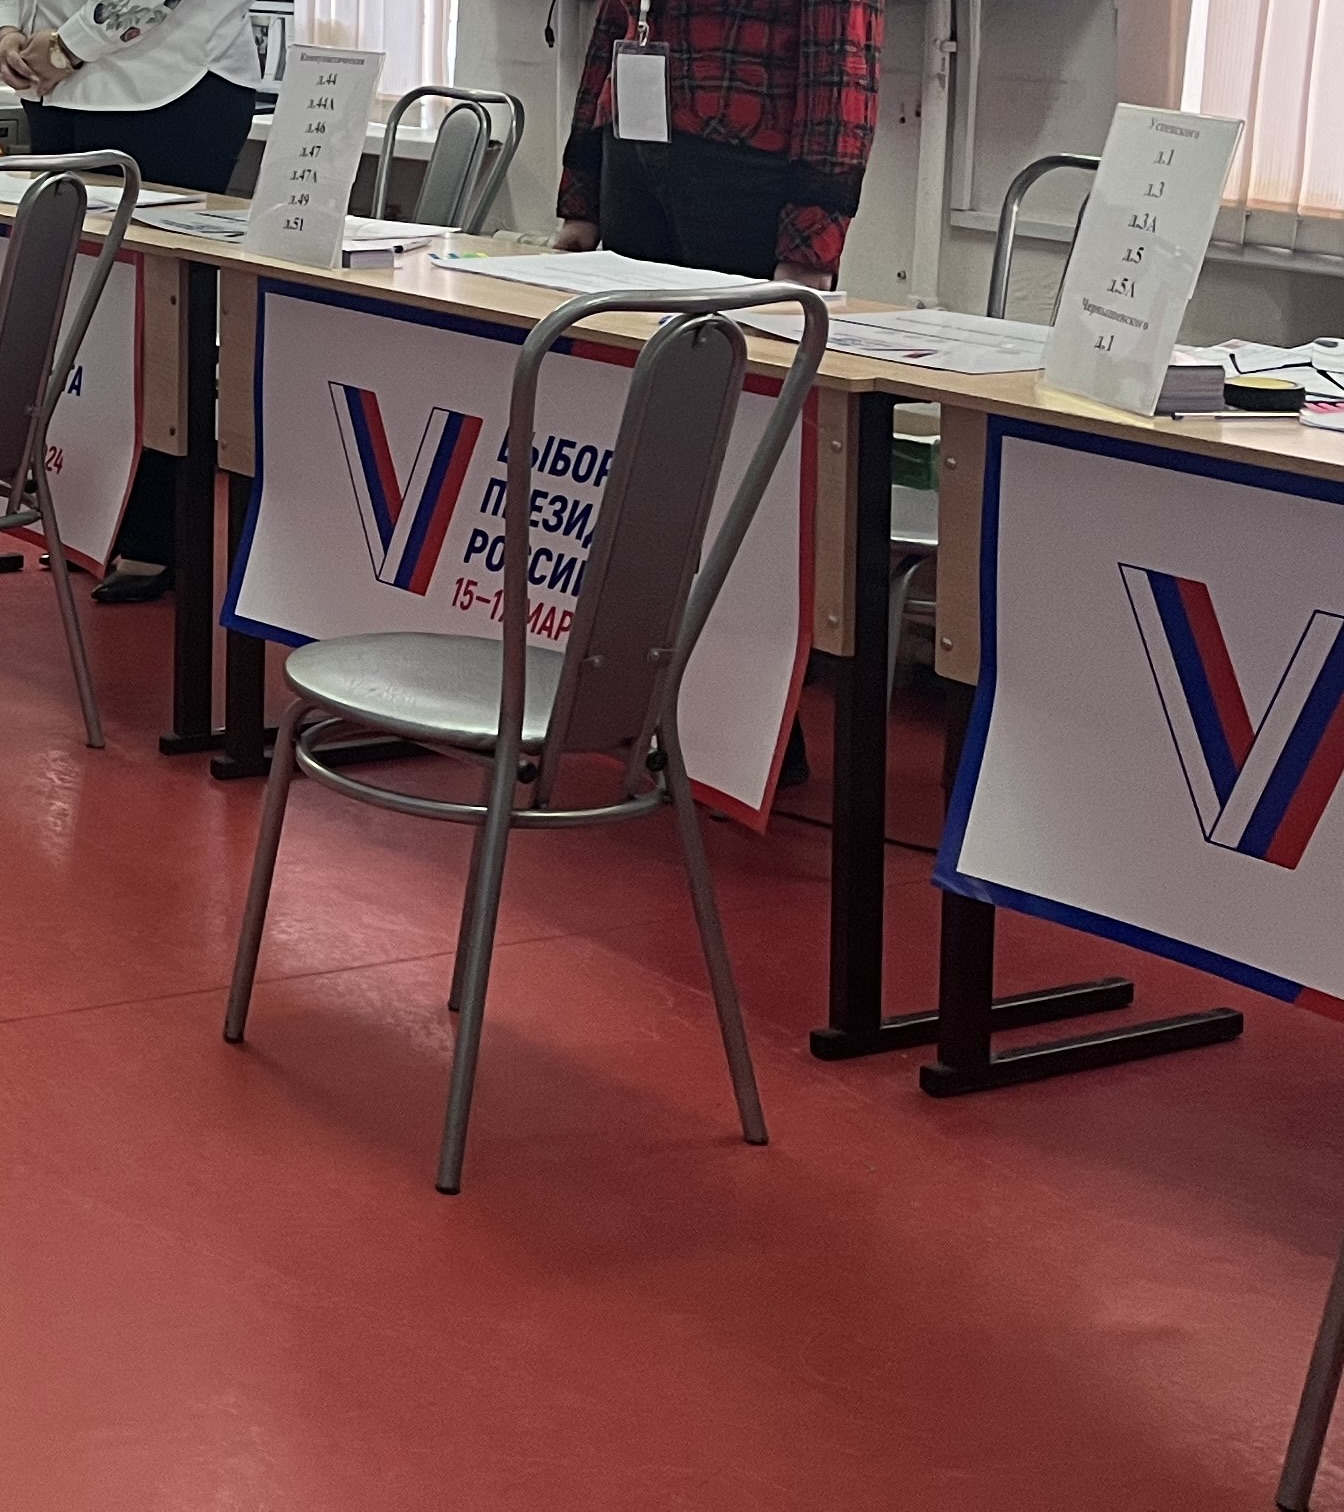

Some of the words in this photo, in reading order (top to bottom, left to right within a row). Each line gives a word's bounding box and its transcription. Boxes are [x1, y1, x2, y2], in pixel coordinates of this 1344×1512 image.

[1154, 149, 1175, 166] д.1
[1143, 181, 1165, 198] д.3
[1128, 213, 1157, 233] д.3А
[1122, 246, 1145, 264] д.5
[1107, 277, 1137, 299] д.5А
[1094, 334, 1115, 352] д.1
